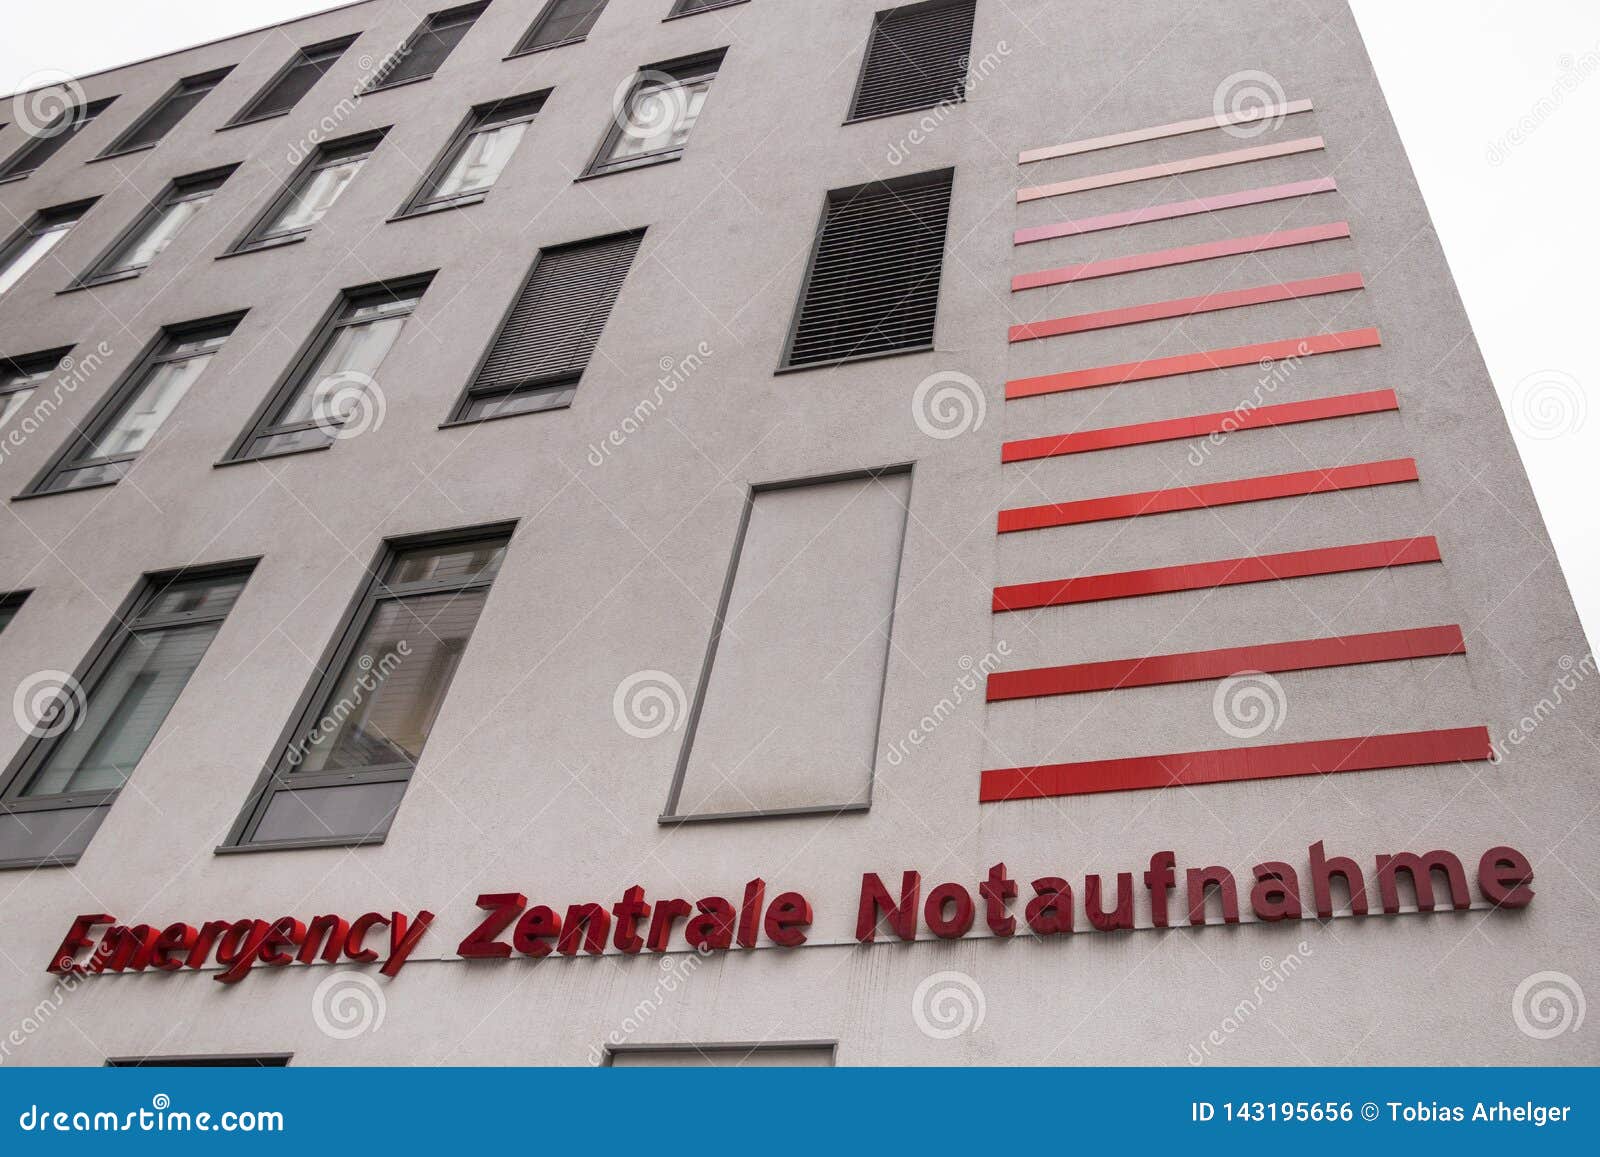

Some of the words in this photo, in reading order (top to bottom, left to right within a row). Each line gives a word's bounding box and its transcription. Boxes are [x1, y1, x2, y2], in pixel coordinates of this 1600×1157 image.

[46, 910, 436, 983] Emergency
[457, 877, 813, 959] Zentrale
[855, 840, 1535, 943] Notaufnahme
